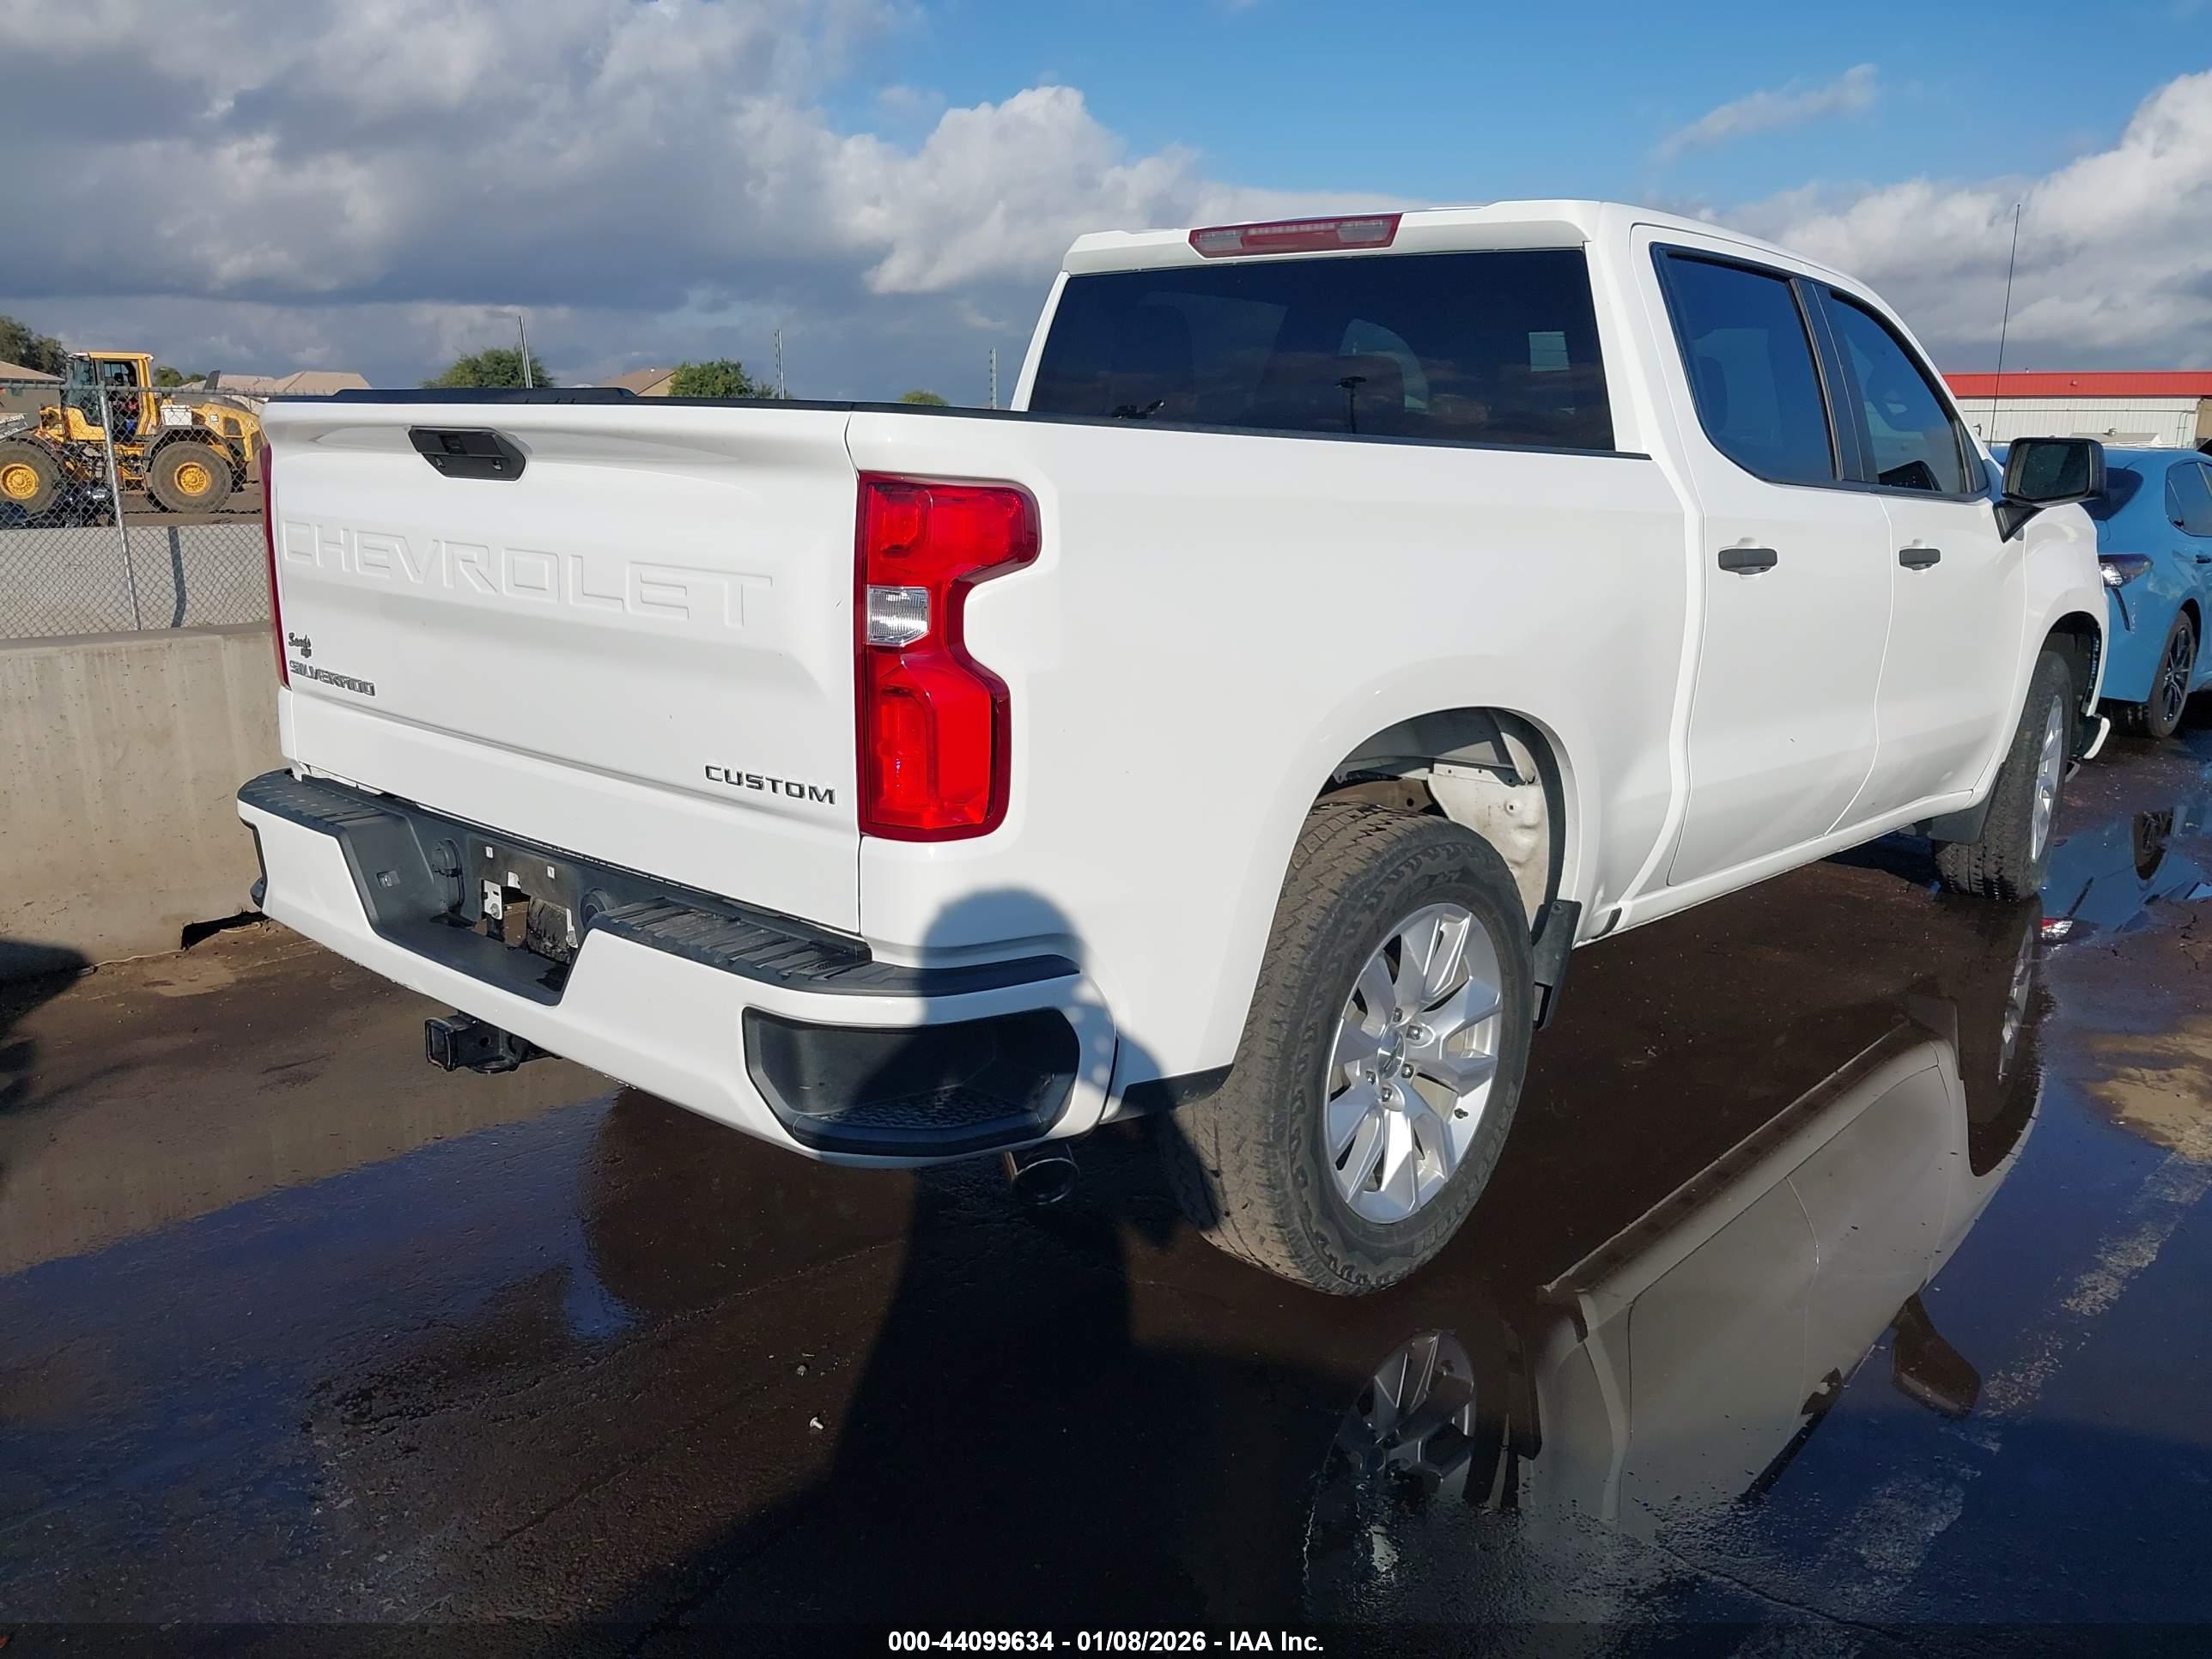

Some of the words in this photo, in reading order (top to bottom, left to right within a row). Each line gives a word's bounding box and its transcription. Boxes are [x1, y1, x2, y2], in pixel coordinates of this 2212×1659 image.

[283, 520, 773, 628] CHEVROLET
[289, 659, 376, 696] SILVERADO
[705, 763, 836, 805] CUSTOM
